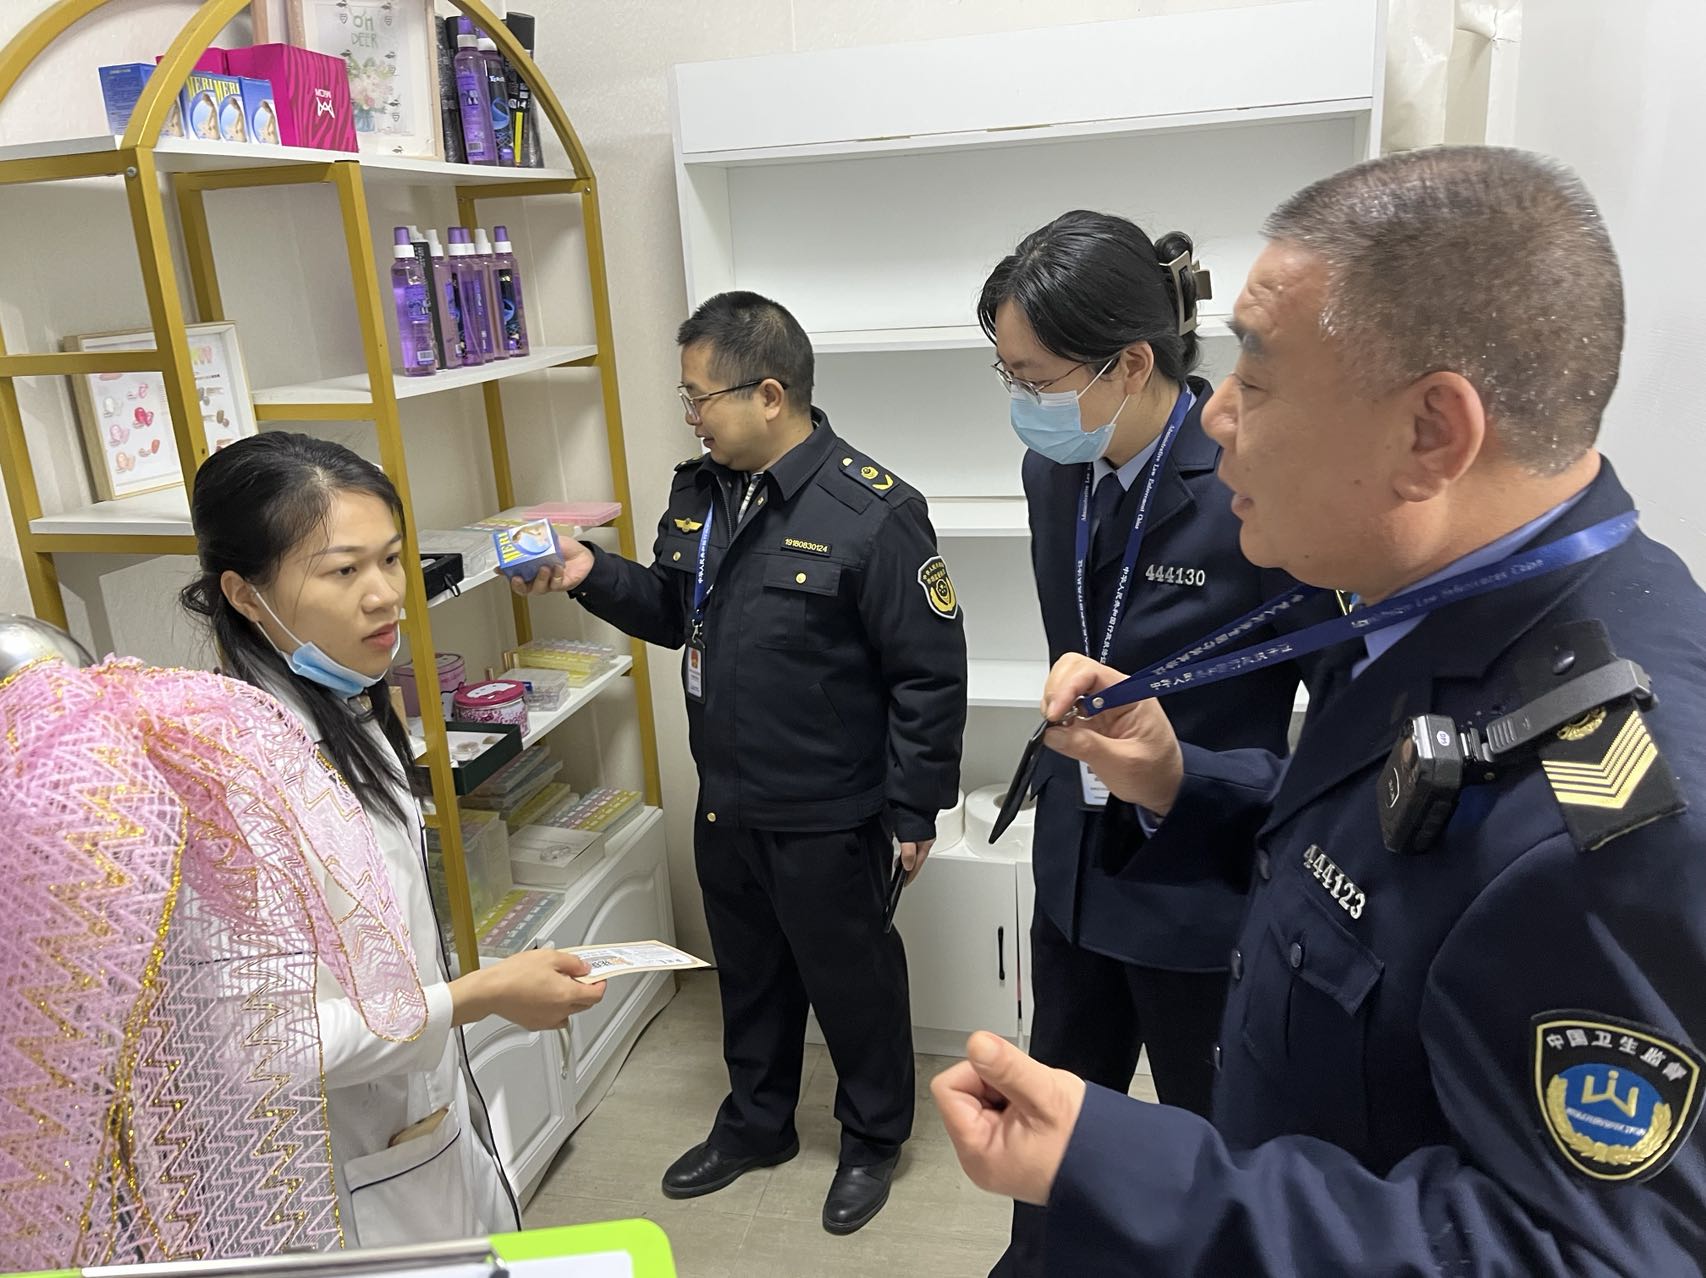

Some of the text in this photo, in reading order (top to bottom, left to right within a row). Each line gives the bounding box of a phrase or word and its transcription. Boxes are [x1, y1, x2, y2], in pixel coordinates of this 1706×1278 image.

[351, 32, 378, 48] DEER
[1145, 563, 1206, 587] 444130
[1303, 844, 1366, 919] 444123
